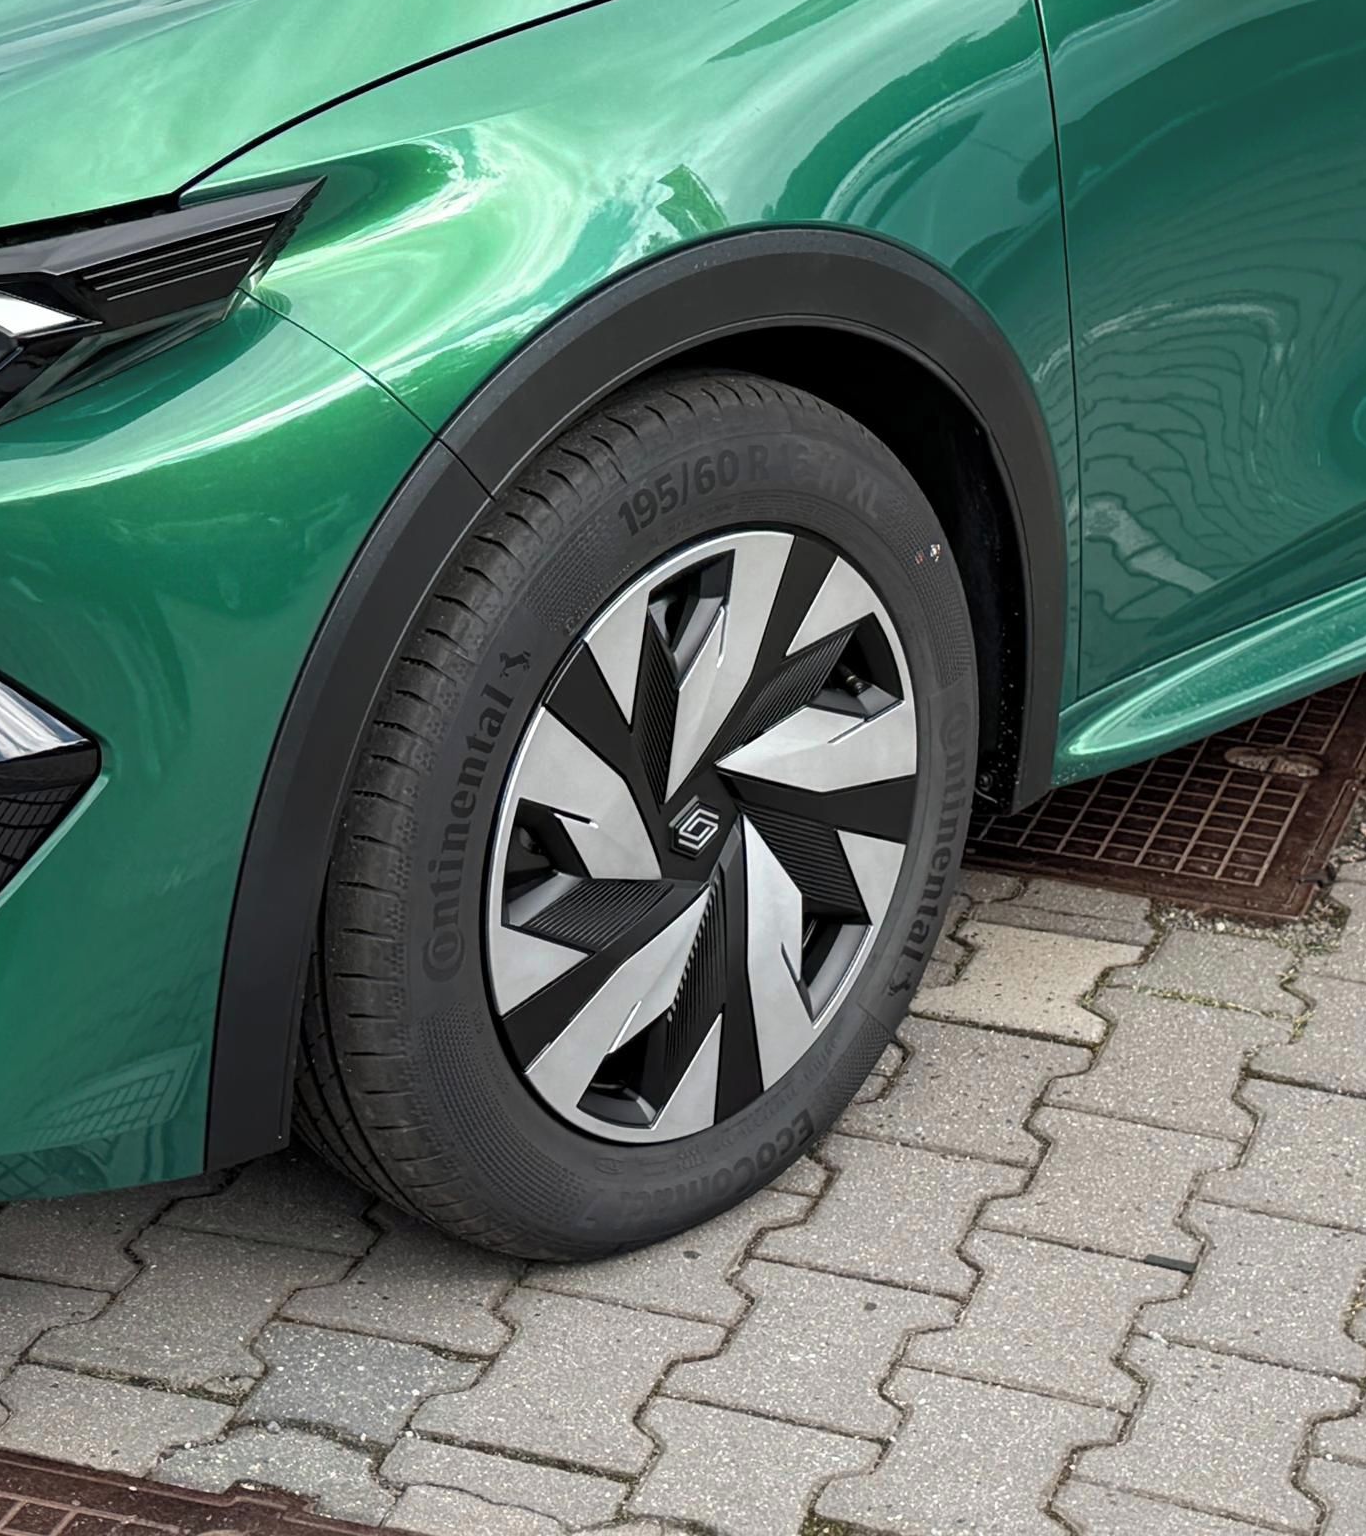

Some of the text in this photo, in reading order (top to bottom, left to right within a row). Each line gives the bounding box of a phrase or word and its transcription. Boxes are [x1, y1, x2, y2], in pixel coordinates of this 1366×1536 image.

[618, 448, 740, 538] 195/60
[421, 681, 514, 983] Continental
[901, 702, 970, 963] Continental
